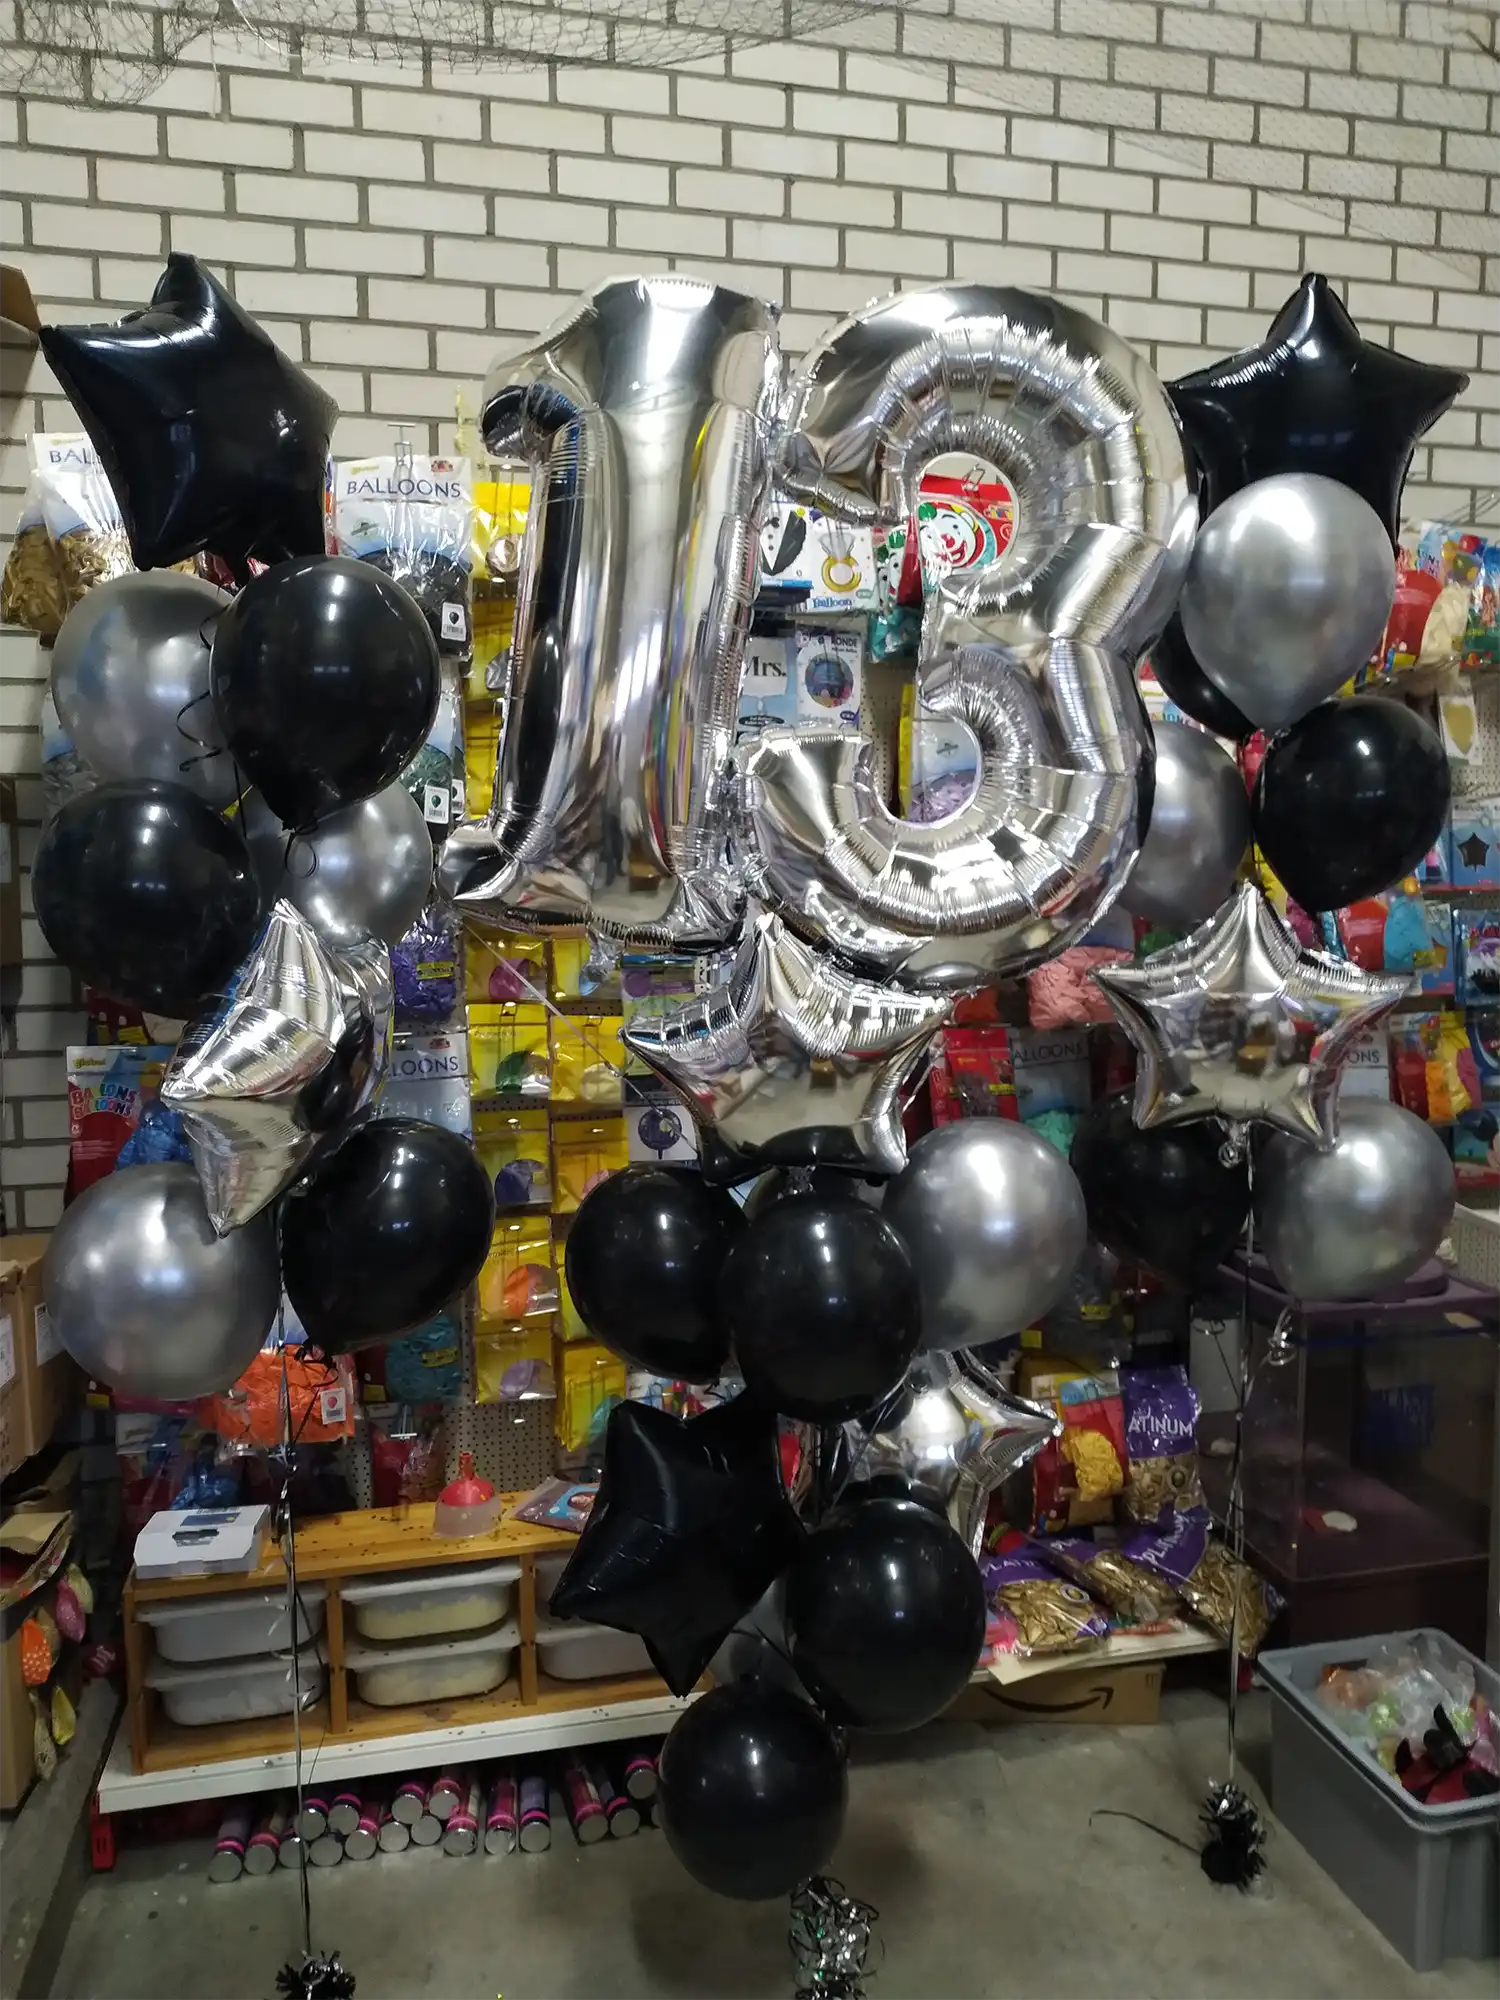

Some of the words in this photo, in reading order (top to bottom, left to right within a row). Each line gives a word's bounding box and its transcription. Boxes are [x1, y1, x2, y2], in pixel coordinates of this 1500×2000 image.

[347, 478, 461, 498] BALLOONS
[1014, 1042, 1081, 1062] ALLOONS
[1347, 1049, 1380, 1065] ONS
[388, 1056, 459, 1077] LOONS
[1127, 1415, 1193, 1437] ATINUM
